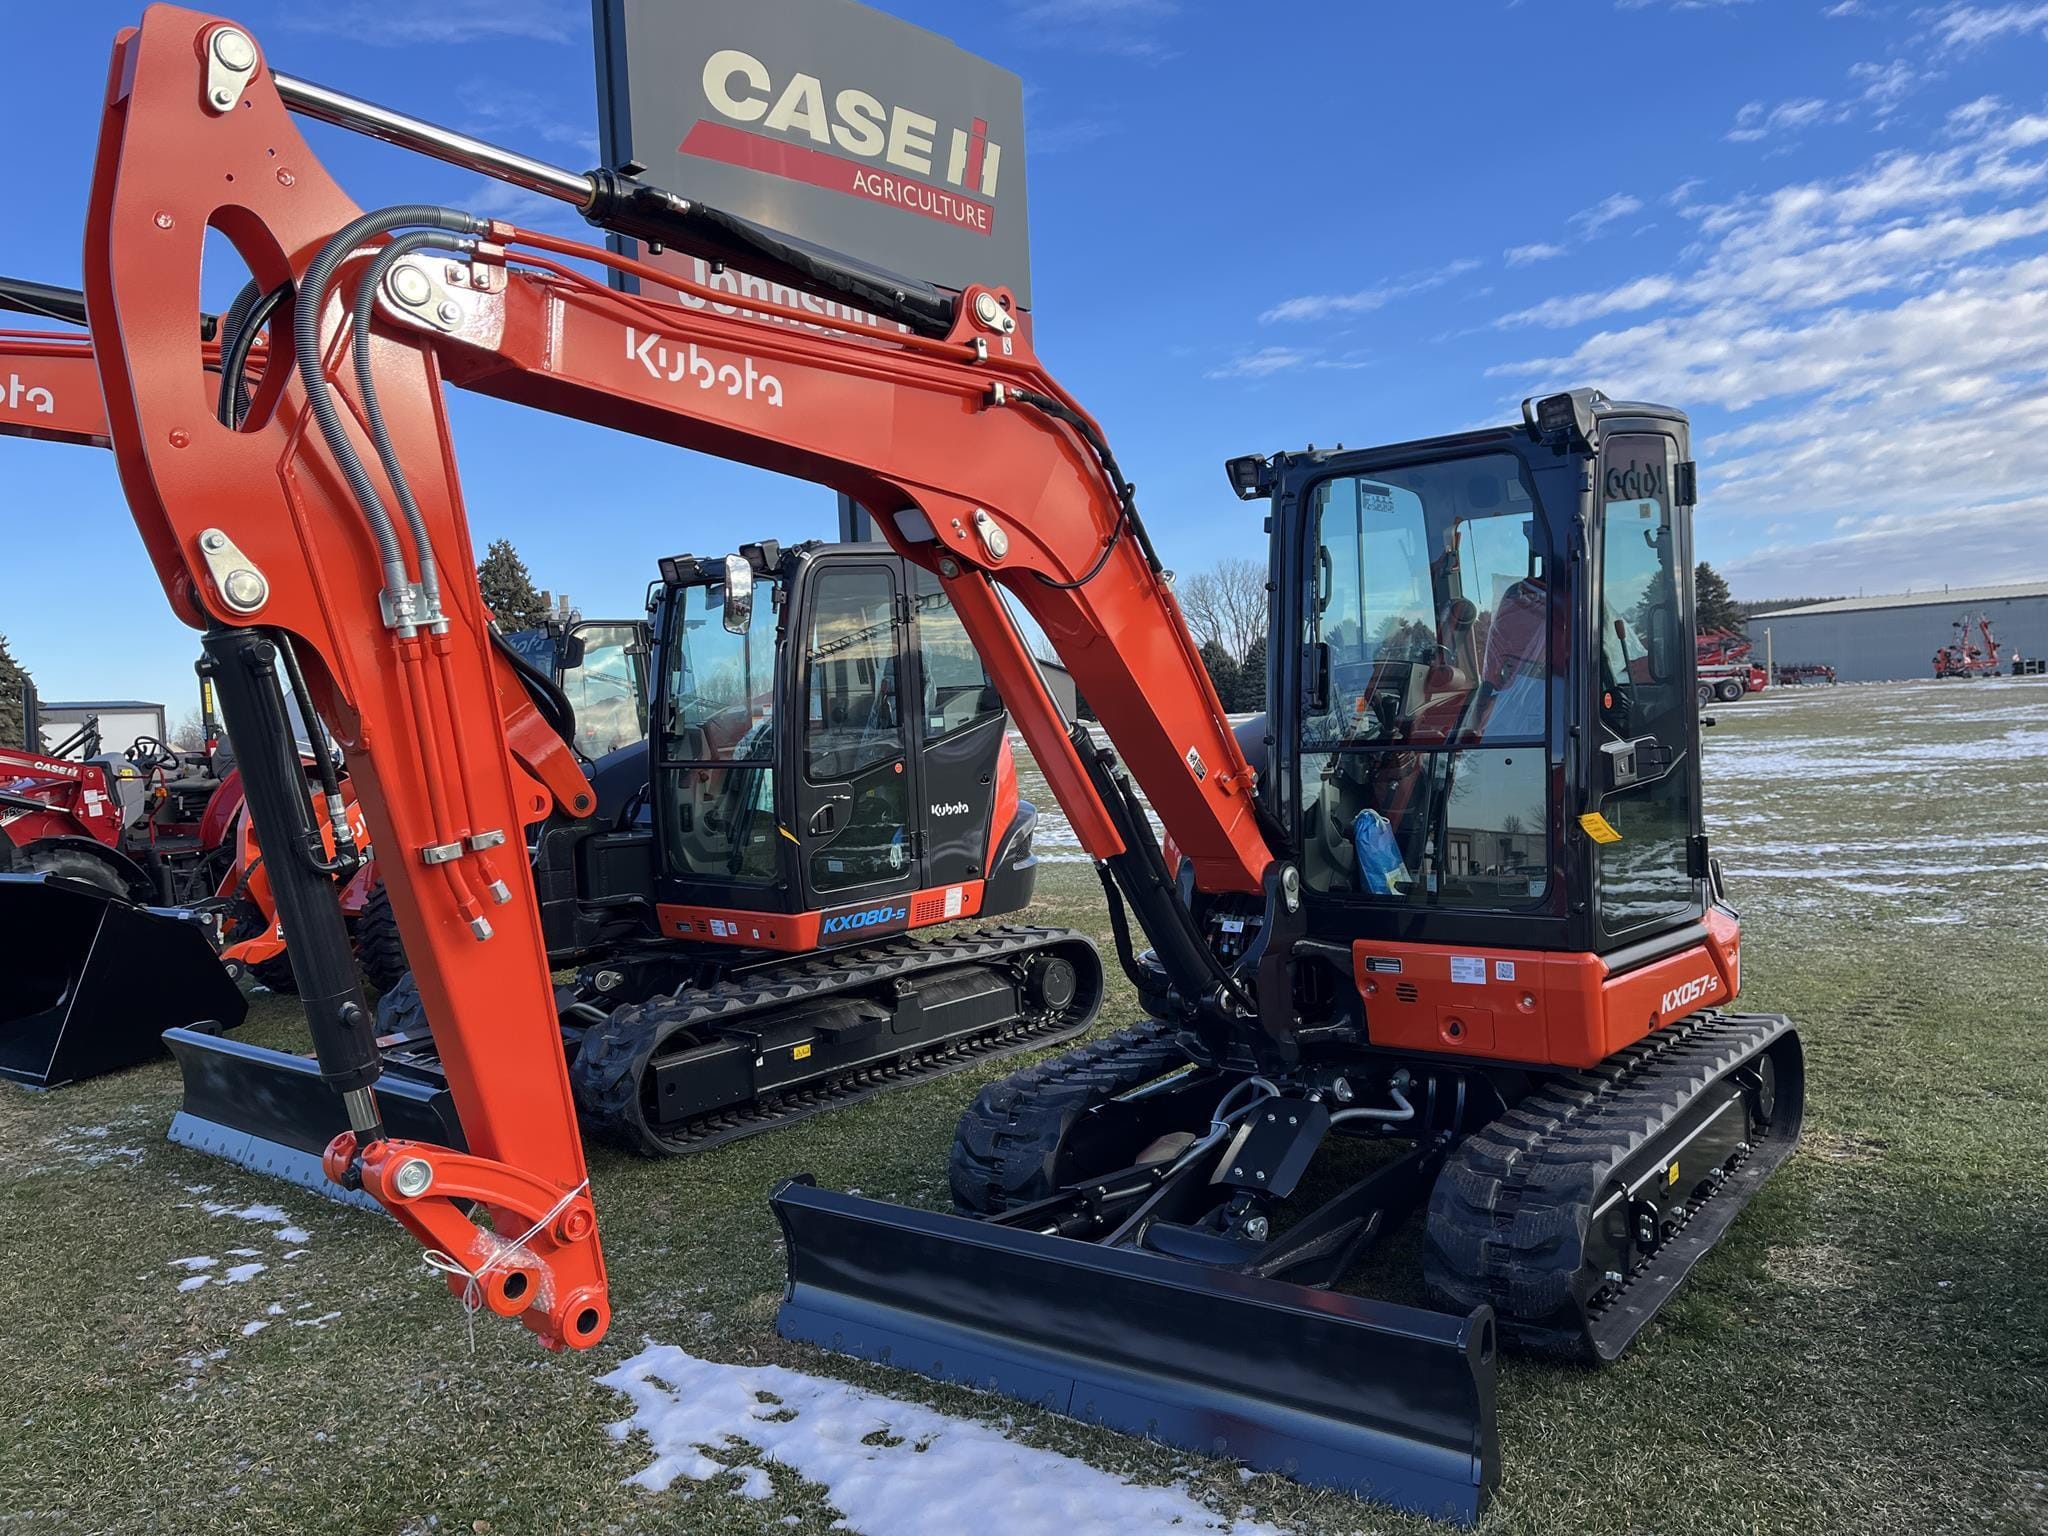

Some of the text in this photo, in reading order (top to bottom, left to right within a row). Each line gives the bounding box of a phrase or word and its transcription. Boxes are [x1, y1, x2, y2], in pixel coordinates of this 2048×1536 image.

[702, 50, 937, 175] CASE
[852, 169, 987, 230] AGRICULTURE
[626, 326, 783, 408] Kubota
[34, 761, 67, 775] CASE
[931, 801, 969, 817] Kubota
[824, 907, 906, 935] KX080-5
[1661, 974, 1718, 1015] KX057-5
